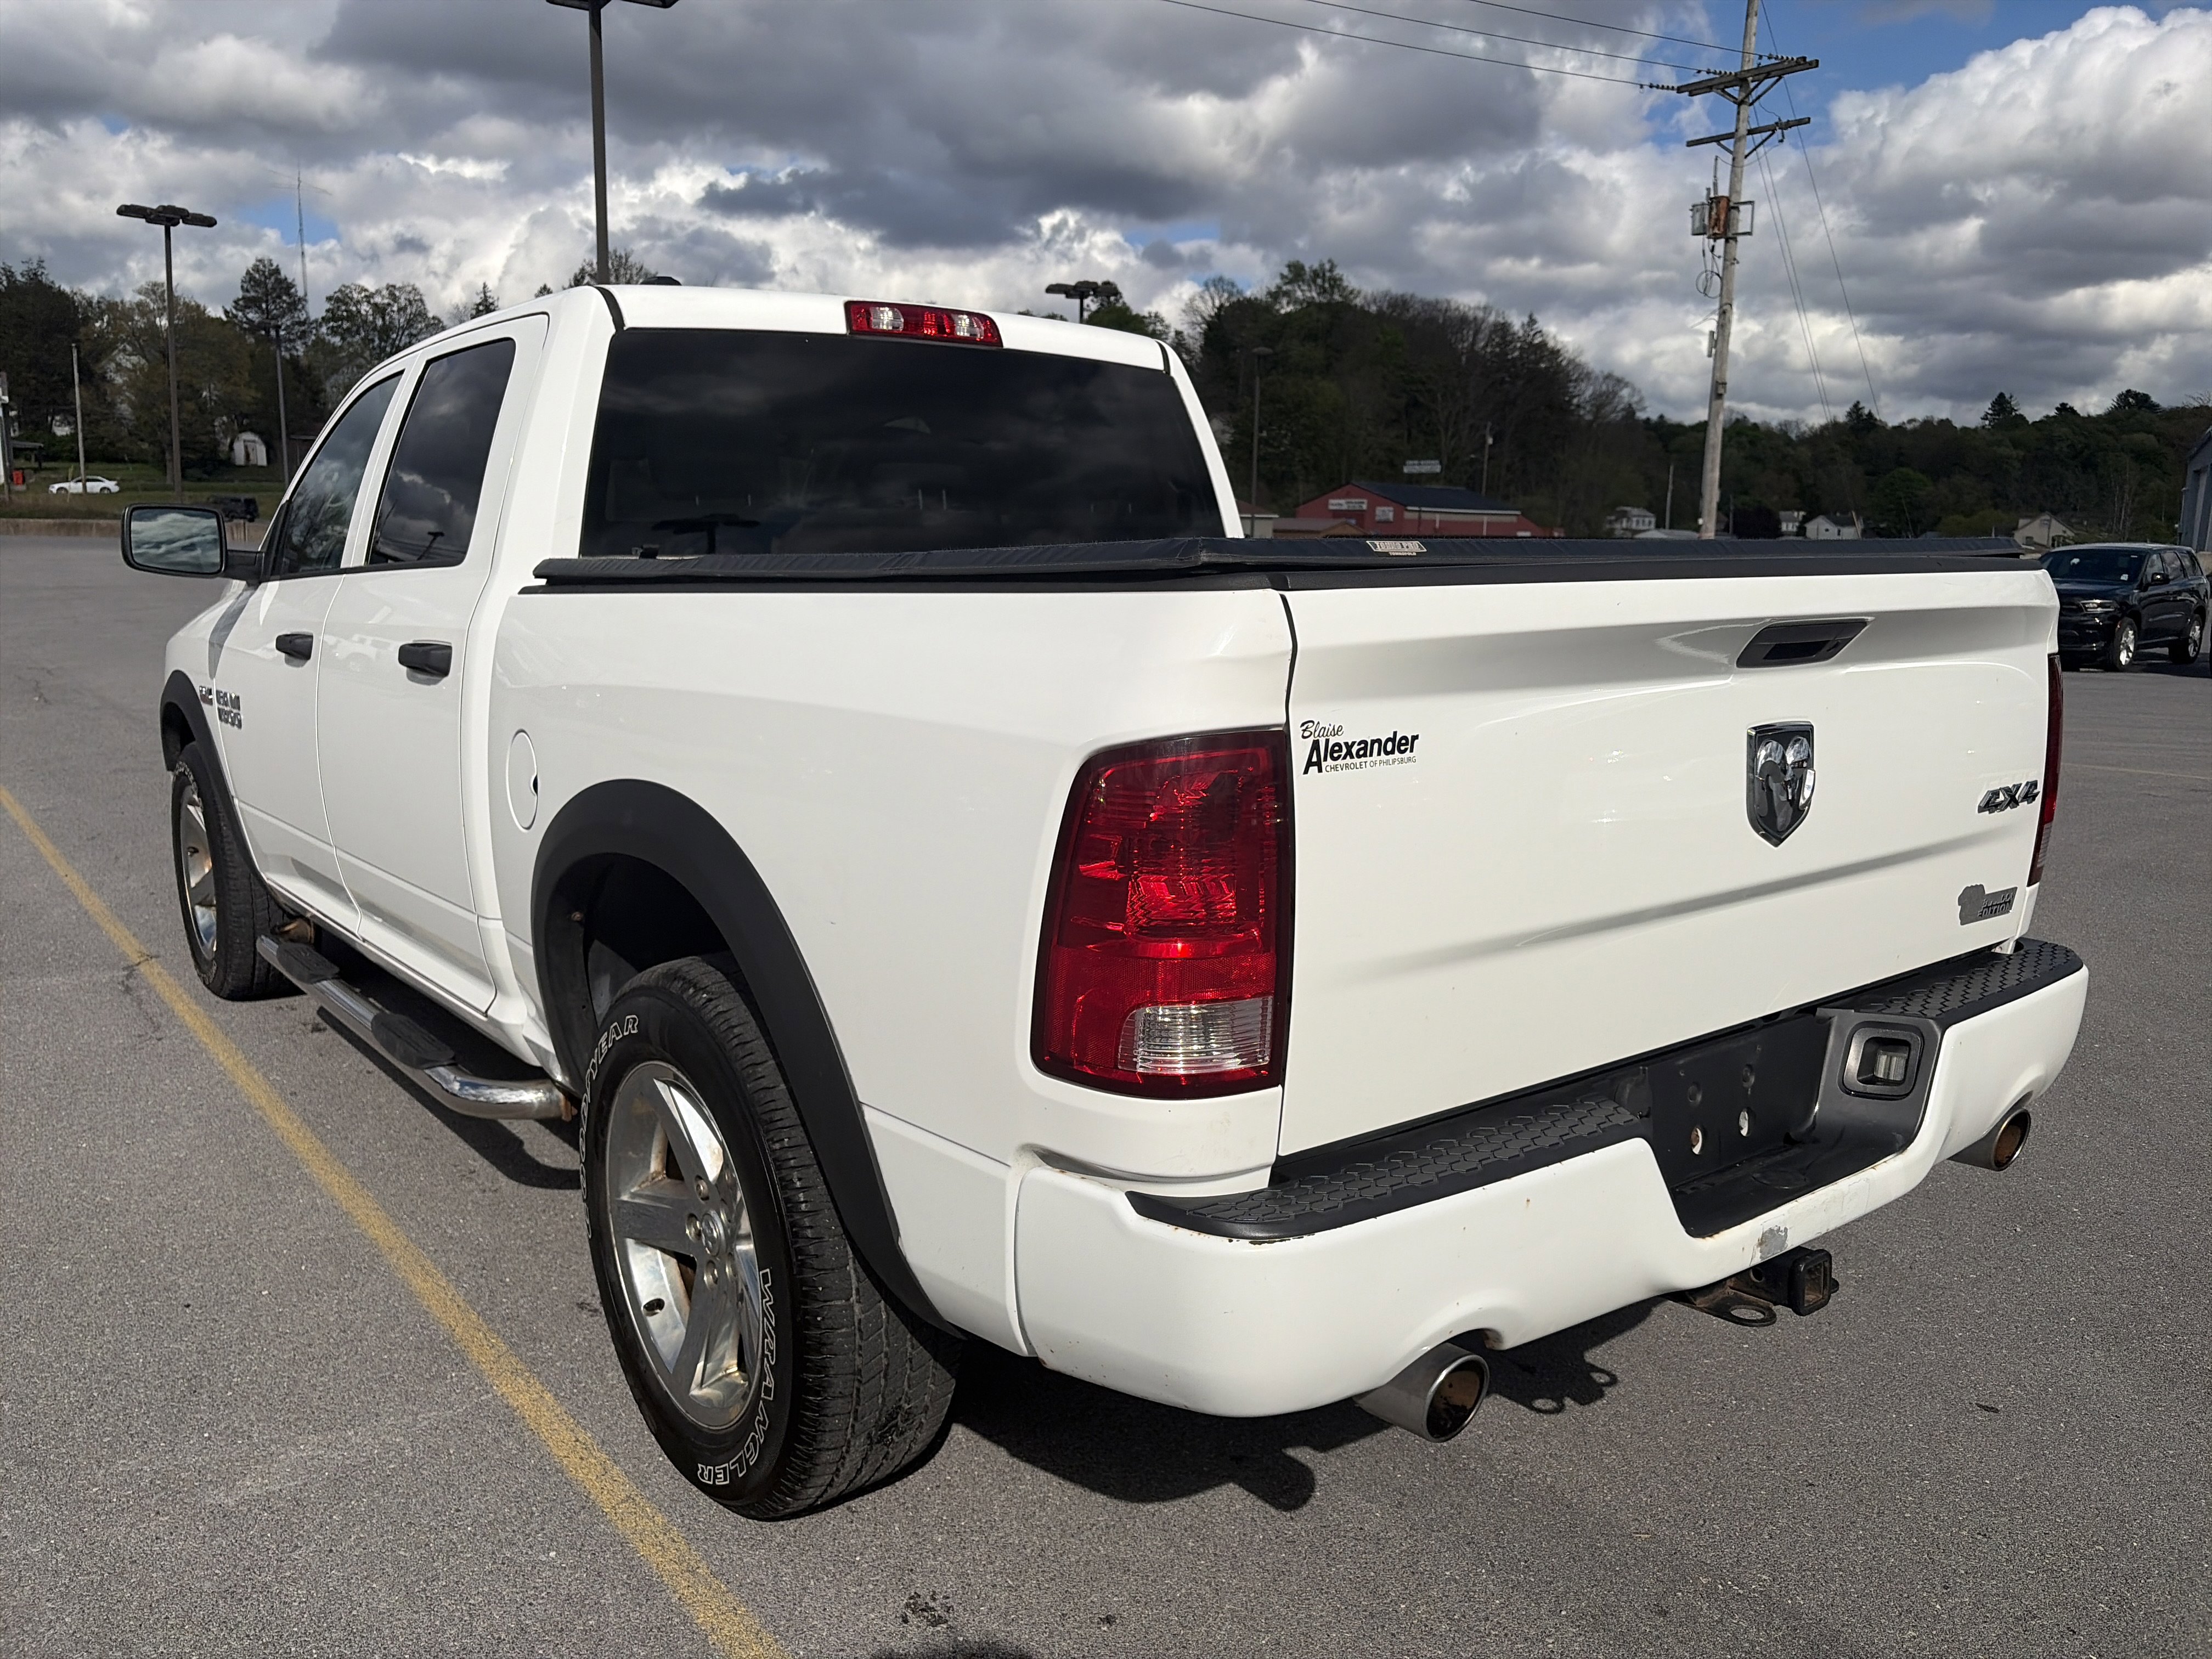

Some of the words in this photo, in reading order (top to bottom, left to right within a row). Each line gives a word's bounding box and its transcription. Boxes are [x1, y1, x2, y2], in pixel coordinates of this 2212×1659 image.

[1300, 719, 1344, 740] Blaise
[1302, 730, 1420, 775] Alexander
[1325, 760, 1368, 773] CHEVROLET
[1369, 759, 1378, 768] OF
[1379, 755, 1417, 768] PHILIPSBURG
[697, 1268, 776, 1486] WRANGLER
